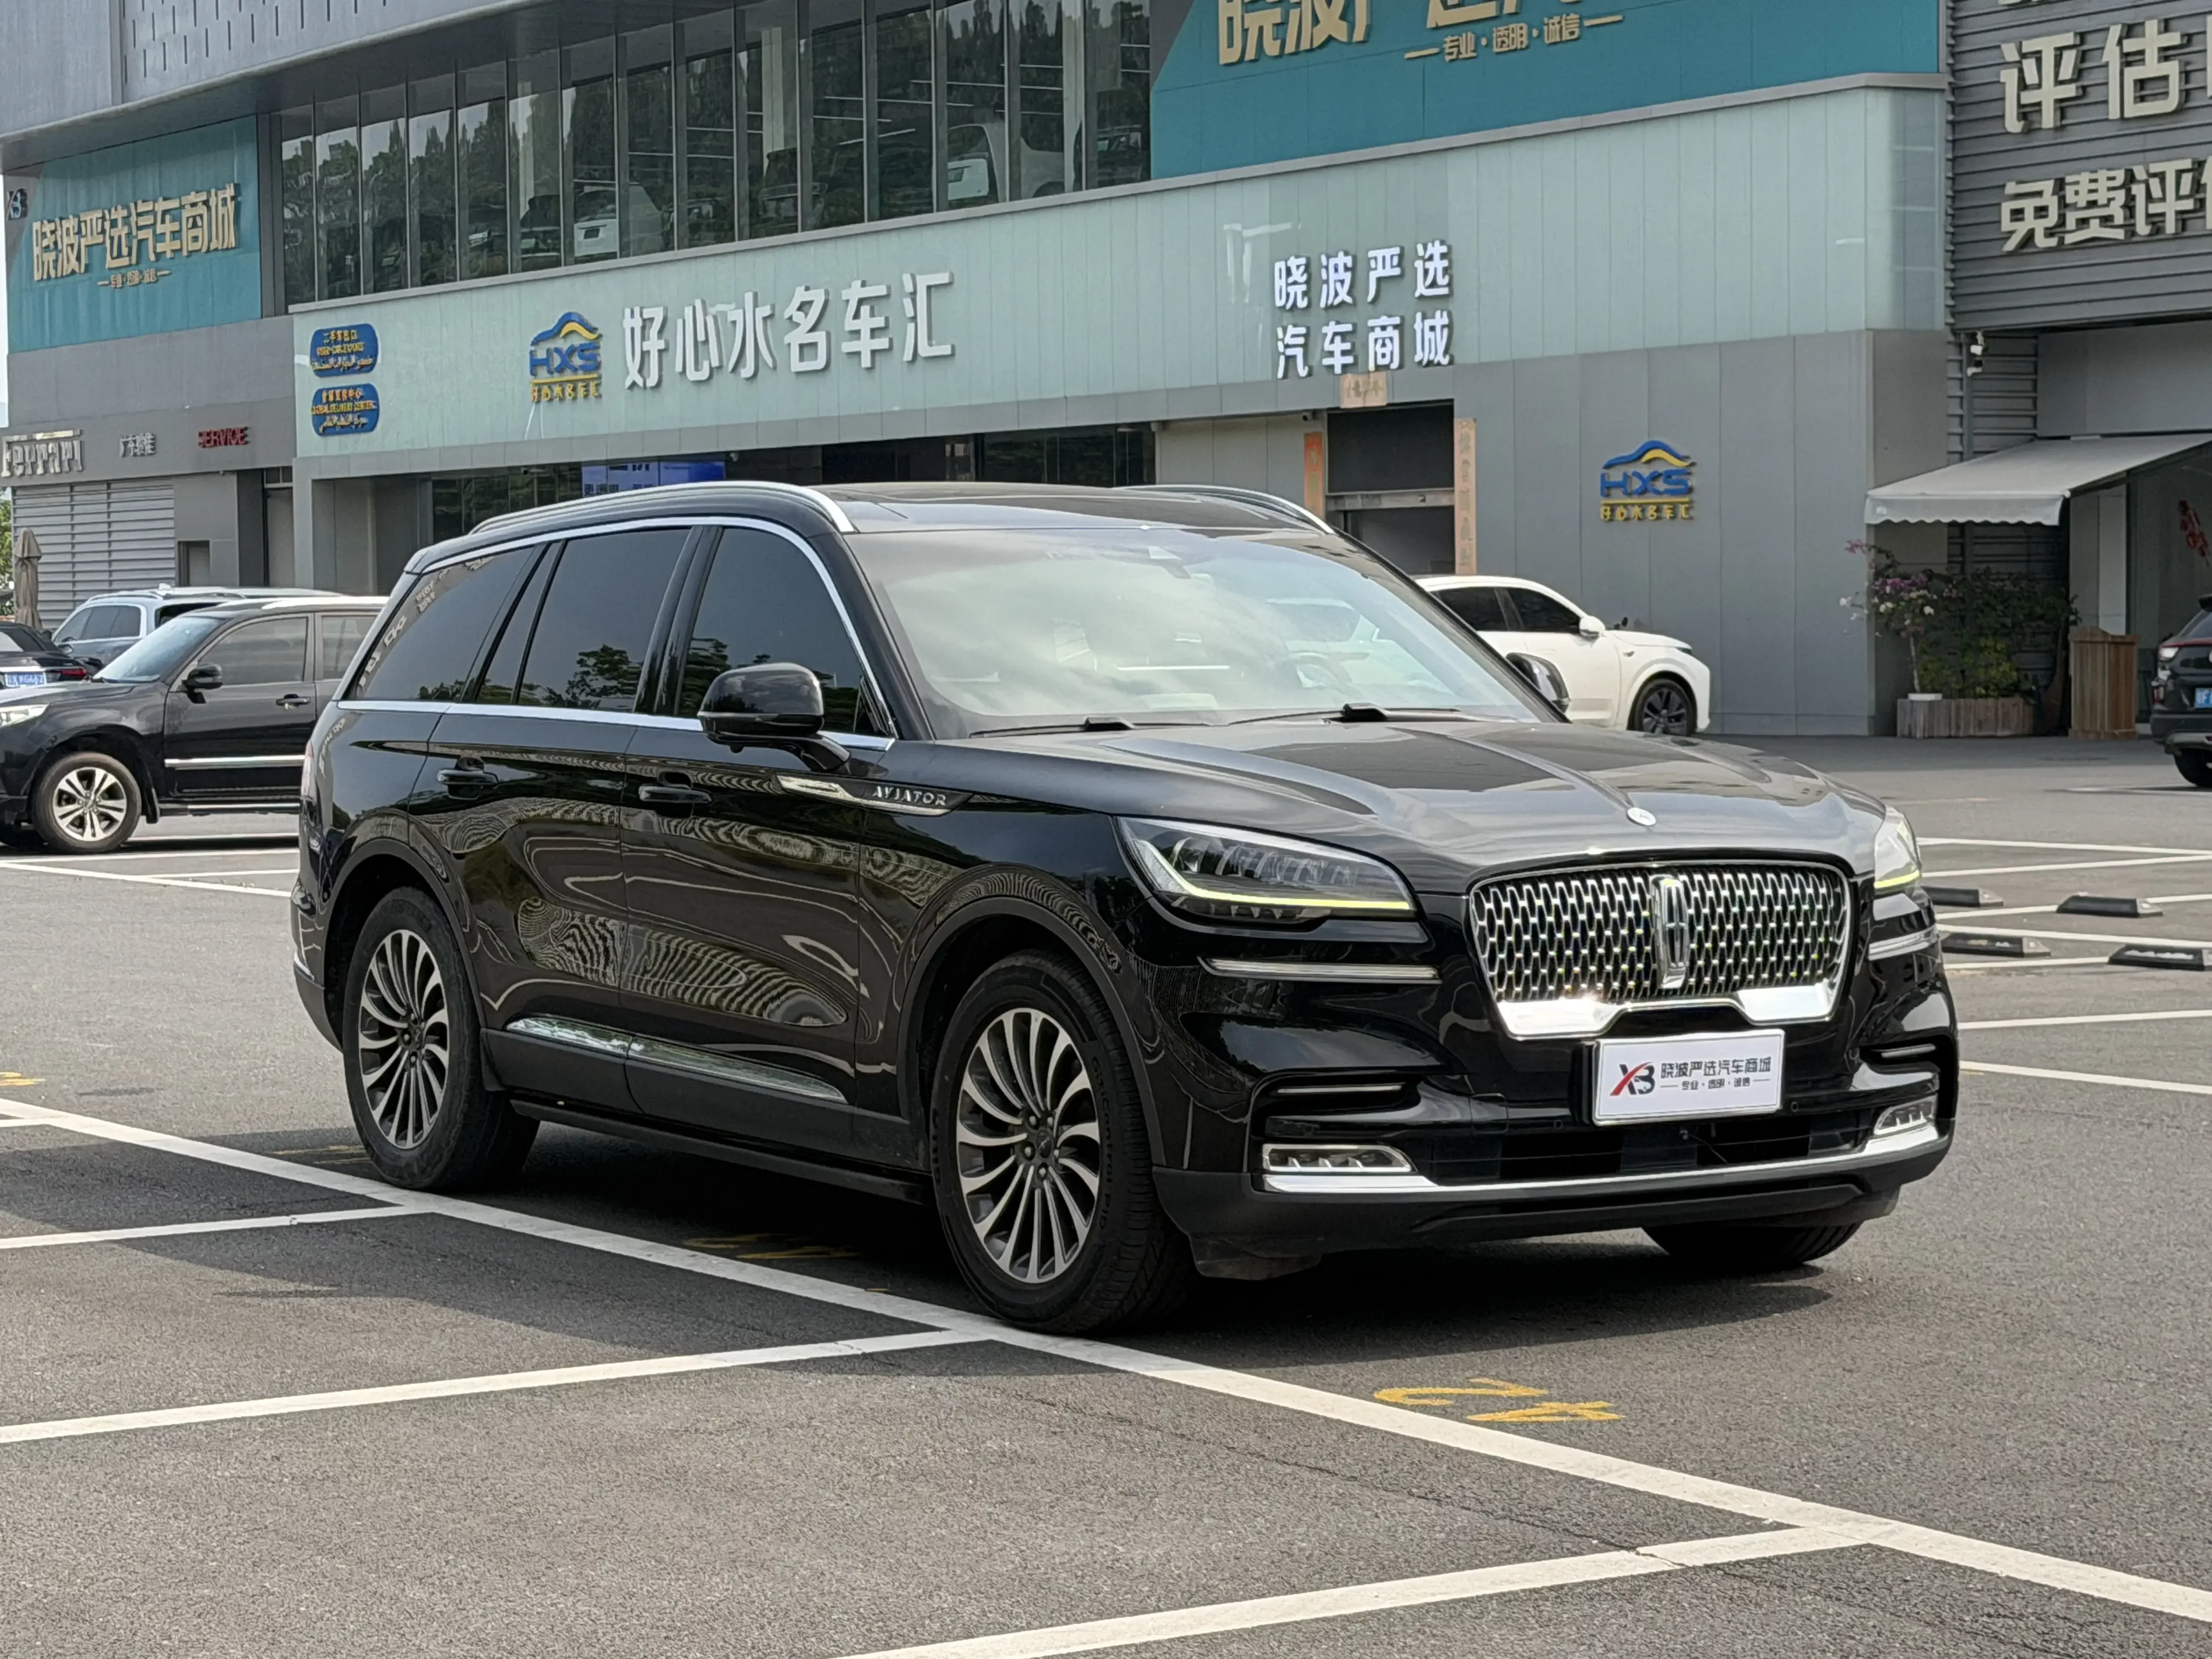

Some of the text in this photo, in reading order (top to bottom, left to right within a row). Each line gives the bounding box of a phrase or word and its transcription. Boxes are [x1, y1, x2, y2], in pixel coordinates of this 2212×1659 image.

[2000, 15, 2212, 133] 评估
[32, 183, 236, 281] 晓波严选汽车商城
[1274, 240, 1450, 311] 晓波严选
[623, 270, 956, 390] 好心水名车汇
[1276, 309, 1451, 380] 汽车商城
[529, 341, 600, 376] HXS
[198, 427, 246, 448] SERVICE
[1600, 469, 1692, 498] HXS
[871, 785, 947, 806] AVIATOR
[1660, 1056, 1772, 1079] 晓波严选汽车商城
